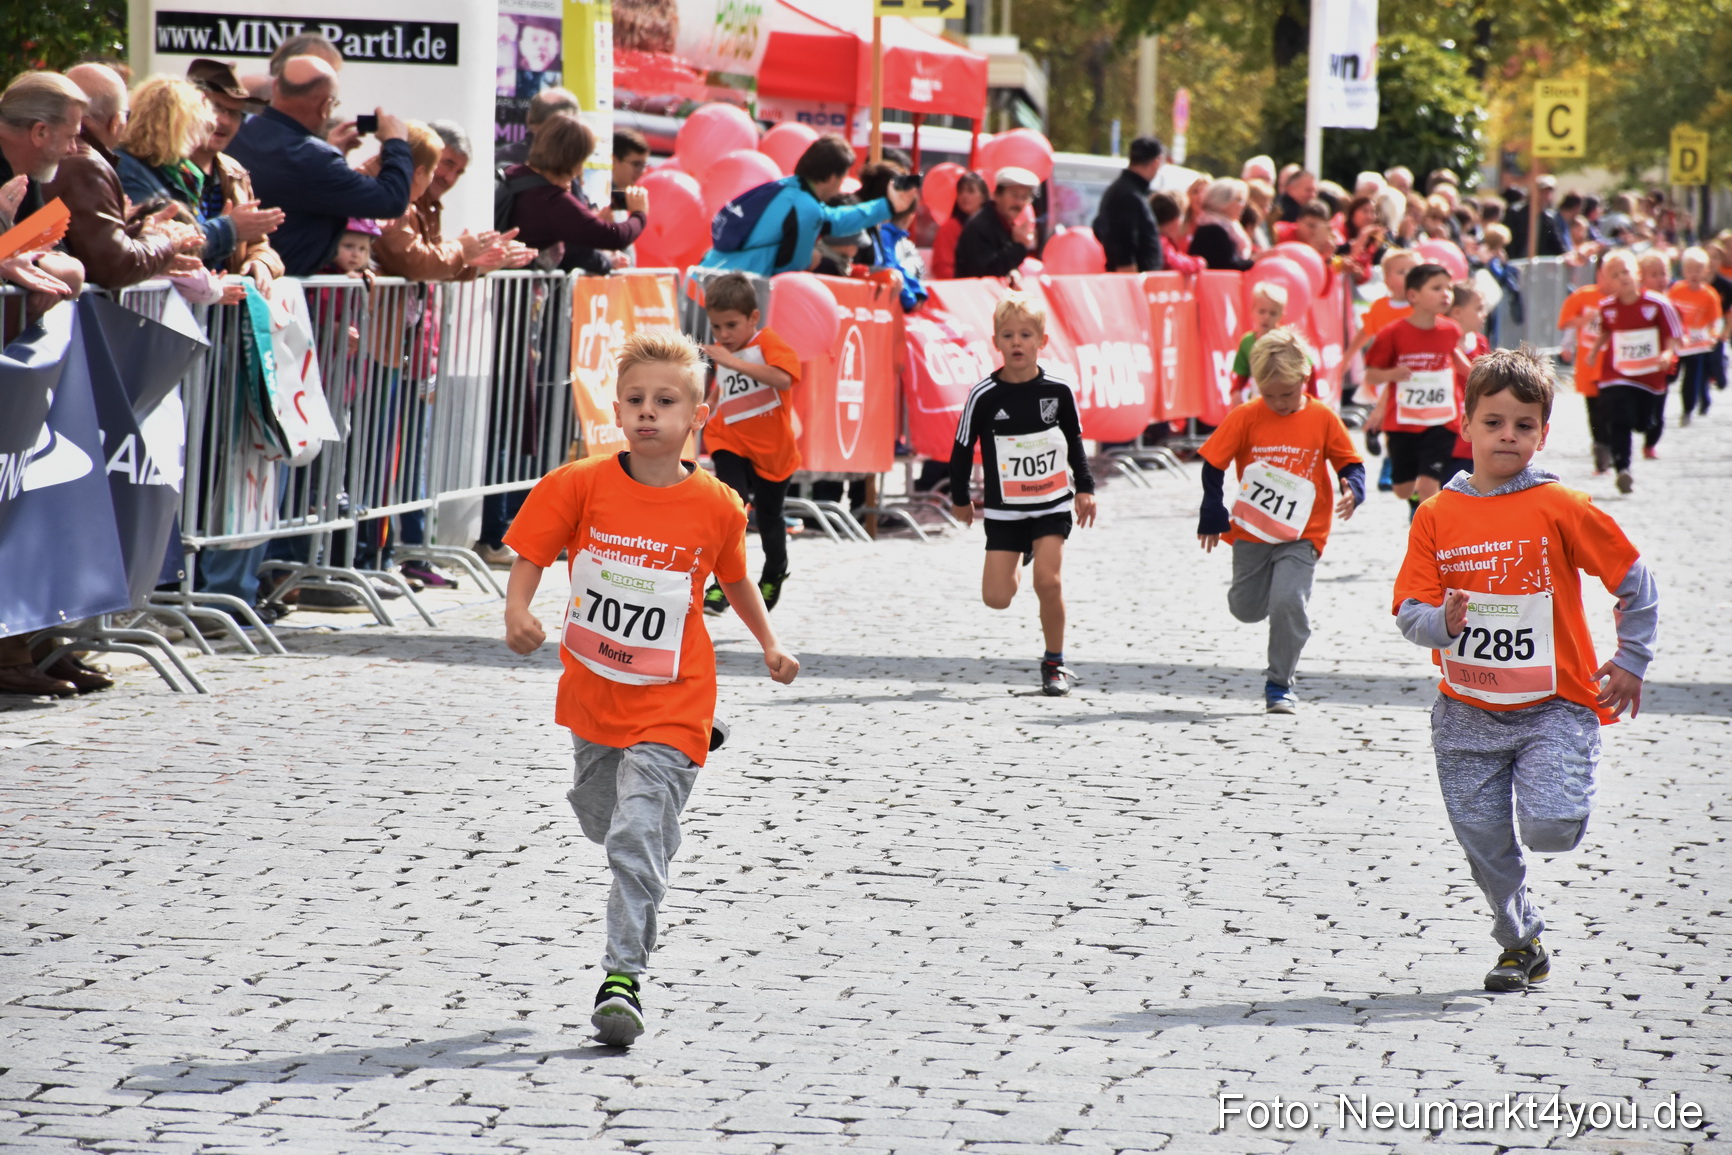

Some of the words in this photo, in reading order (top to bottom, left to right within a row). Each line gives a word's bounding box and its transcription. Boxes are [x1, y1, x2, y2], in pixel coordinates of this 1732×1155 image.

[157, 19, 447, 59] www.MINPartl.de
[1547, 104, 1571, 138] C
[1680, 148, 1699, 173] D
[1405, 388, 1445, 405] 7246
[1008, 449, 1057, 477] 7057
[1021, 481, 1054, 493] Benjamin
[1250, 481, 1298, 520] 7211
[590, 526, 668, 552] Neumarkter
[1436, 540, 1513, 561] Neumarkter
[588, 544, 648, 567] Stadtlauf
[1440, 556, 1498, 575] Stadtlauf
[612, 573, 655, 591] BOCK
[586, 588, 666, 641] 7070
[1478, 603, 1519, 614] BOCK
[598, 642, 633, 664] Moritz
[1457, 626, 1535, 662] 7285
[1460, 669, 1498, 686] DIOR
